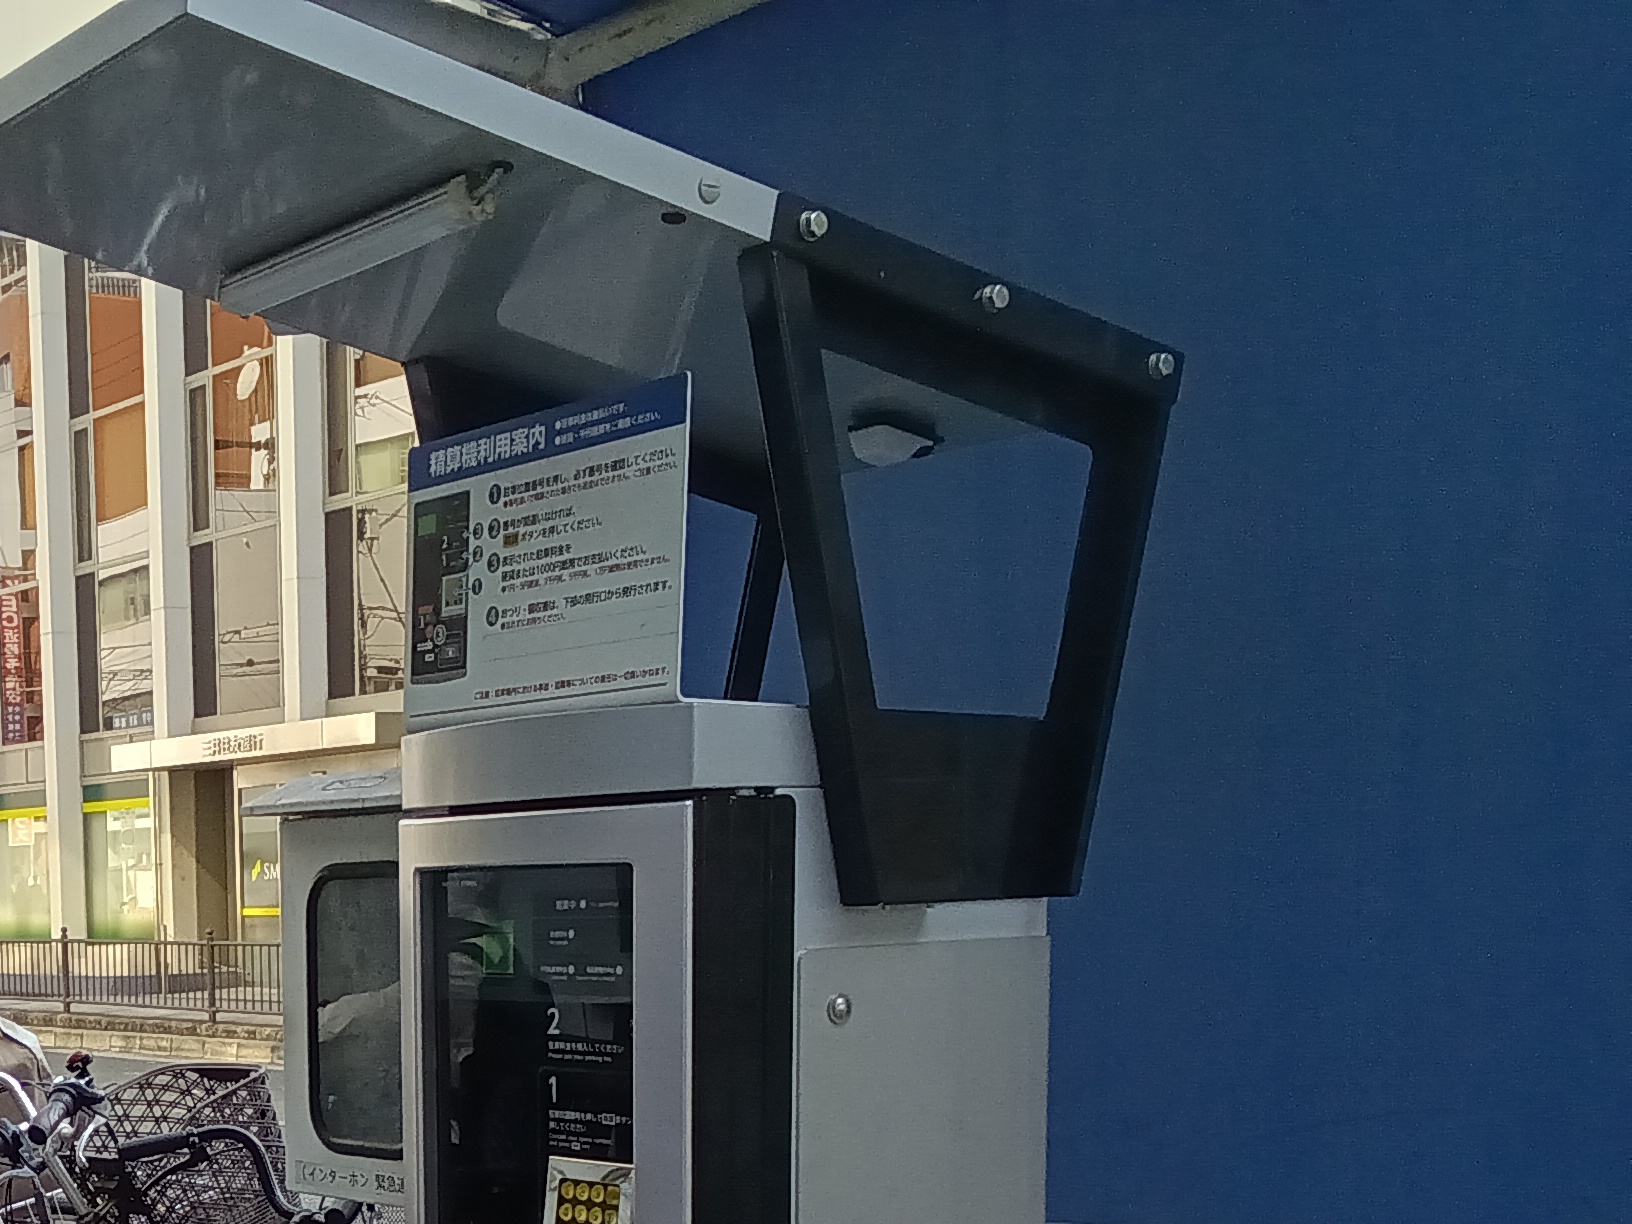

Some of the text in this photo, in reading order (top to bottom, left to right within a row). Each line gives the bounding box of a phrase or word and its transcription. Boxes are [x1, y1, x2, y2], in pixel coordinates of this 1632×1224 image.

[429, 424, 547, 477] 精算機利用案内
[547, 1008, 561, 1035] 2
[548, 1075, 557, 1104] 1
